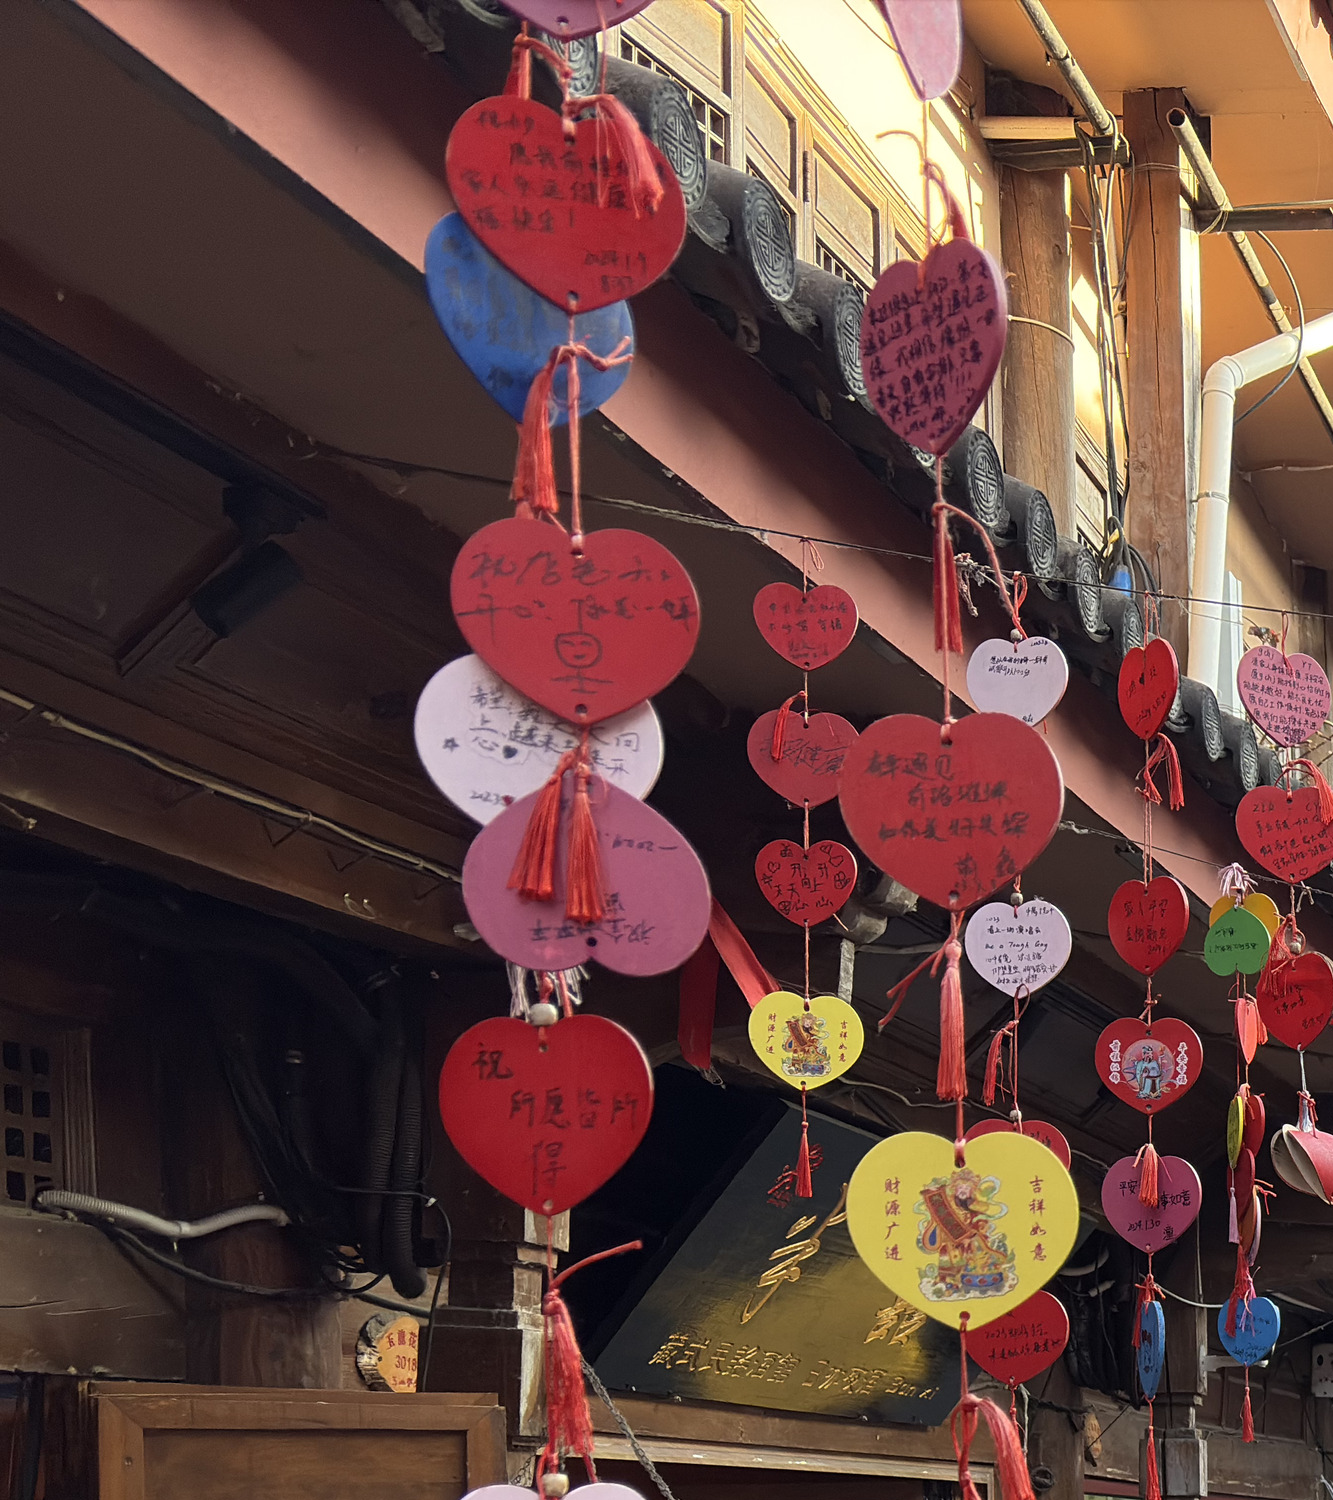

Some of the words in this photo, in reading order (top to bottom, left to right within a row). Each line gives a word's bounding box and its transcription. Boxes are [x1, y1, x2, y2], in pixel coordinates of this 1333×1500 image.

[766, 1012, 778, 1054] 财源广进
[837, 1019, 848, 1063] 吉祥如意
[884, 1176, 903, 1261] 财源广进
[1029, 1175, 1047, 1262] 吉祥如意
[395, 1355, 417, 1372] 3018
